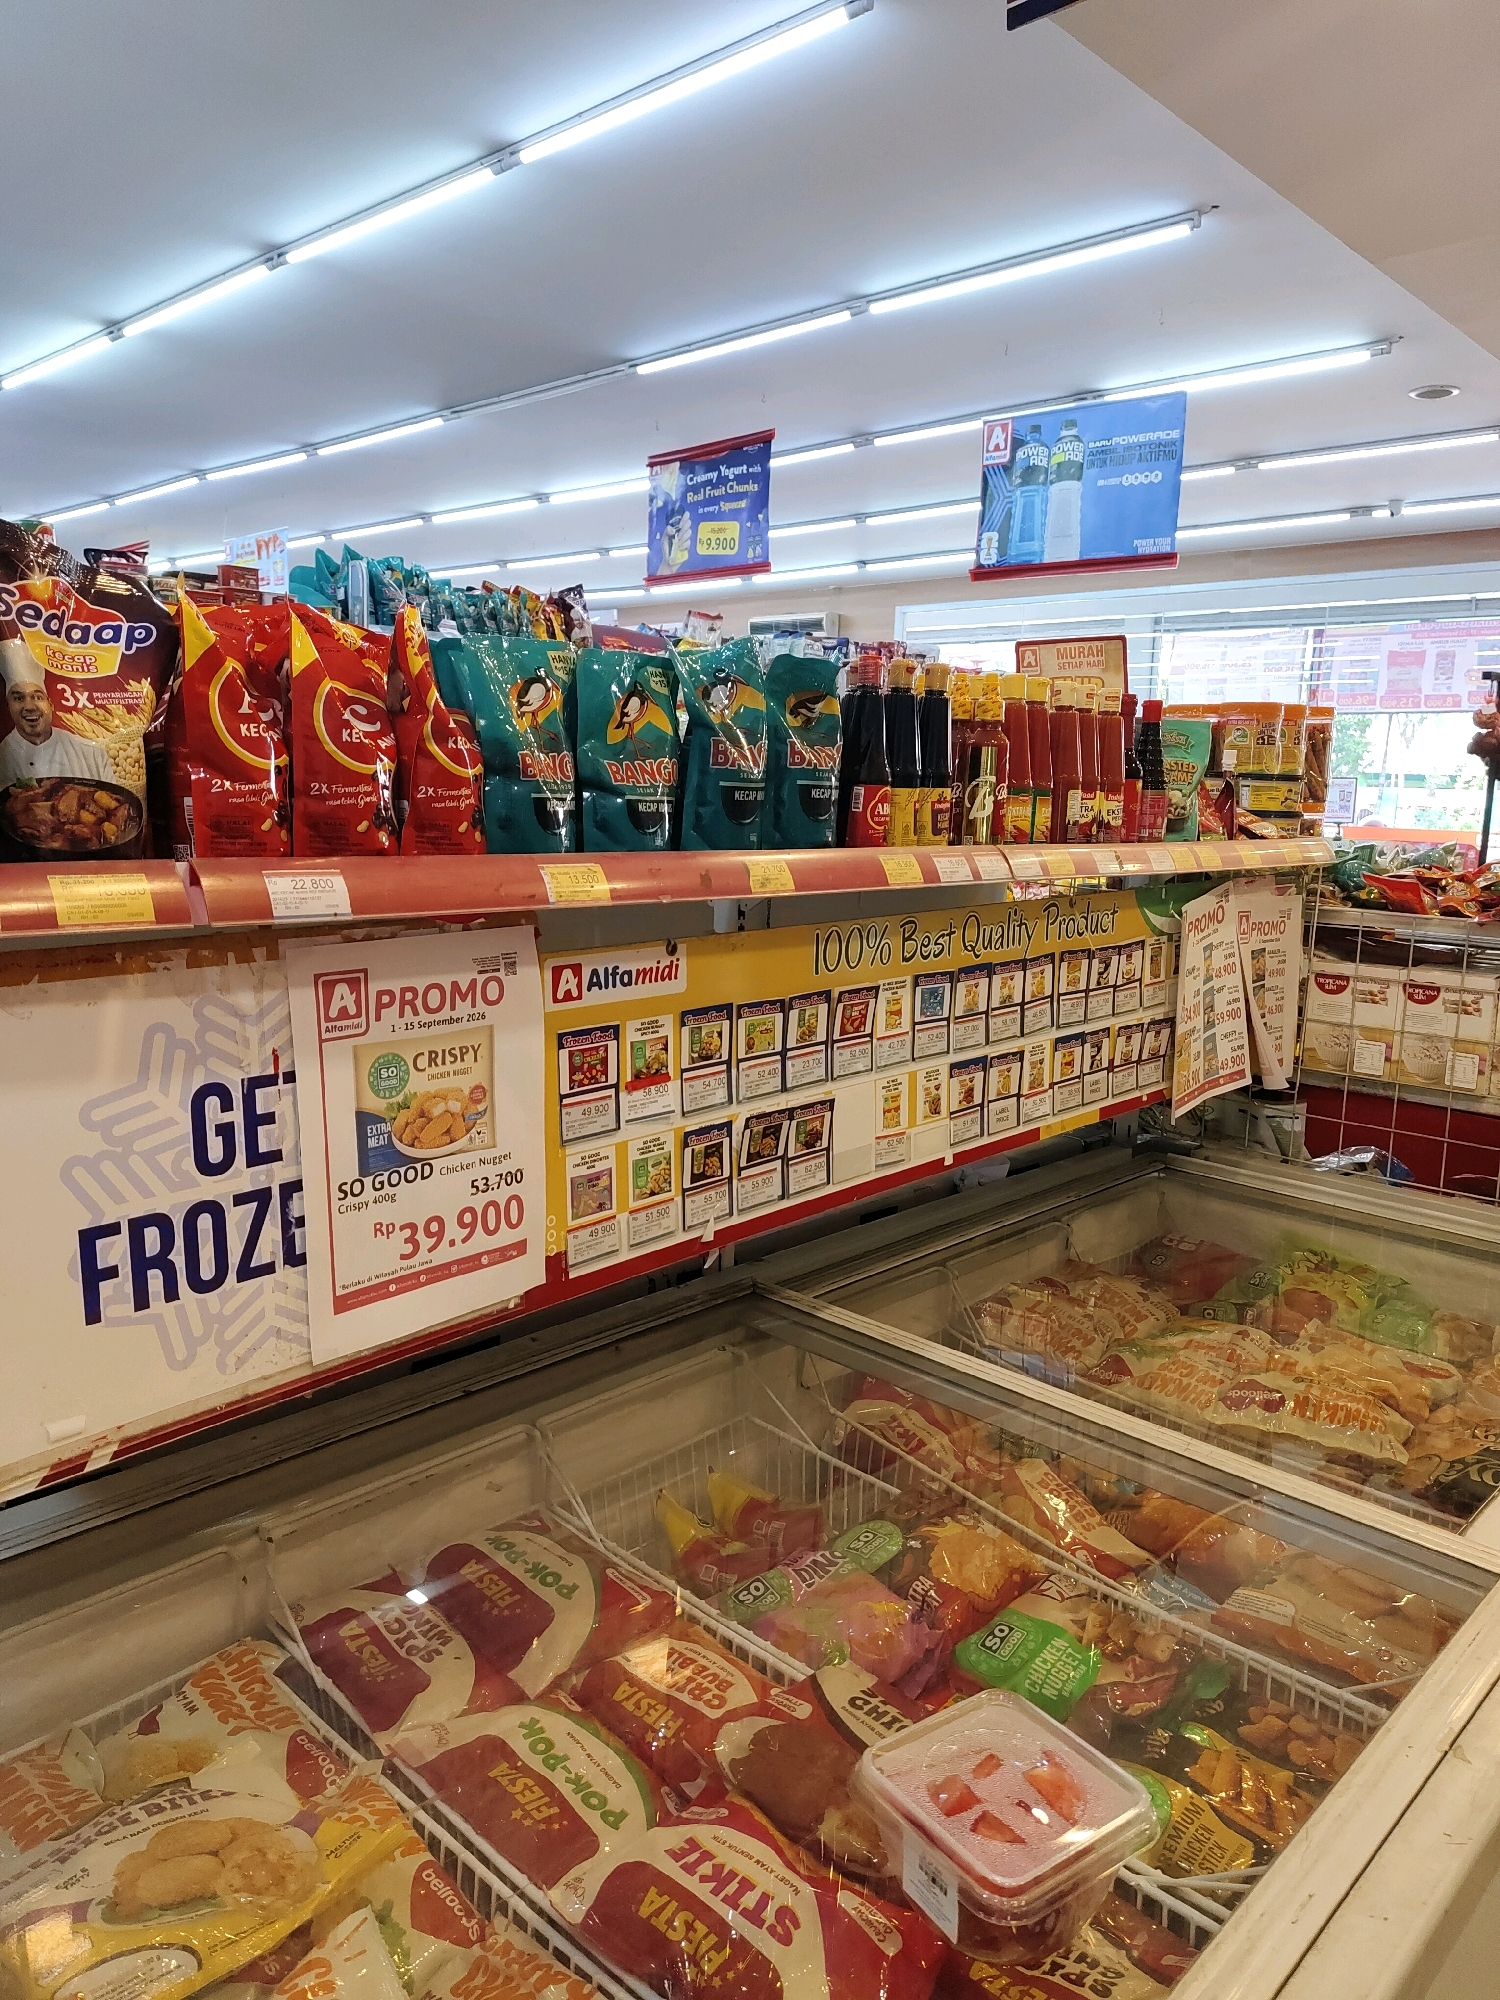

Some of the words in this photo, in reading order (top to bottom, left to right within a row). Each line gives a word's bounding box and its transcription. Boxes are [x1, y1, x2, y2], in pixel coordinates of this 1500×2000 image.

[1088, 439, 1112, 449] BARU
[1111, 429, 1180, 446] POWERADE
[1123, 440, 1178, 453] ISOTONIK
[1016, 446, 1049, 462] POWER
[1051, 442, 1084, 455] POWER
[1065, 450, 1084, 463] ADE
[1029, 455, 1049, 468] ADE
[1086, 457, 1108, 470] UNTUK
[1137, 449, 1178, 463] AKTIFMU
[687, 470, 718, 486] Creamy
[720, 464, 748, 480] Yogurt
[748, 463, 762, 474] with
[687, 488, 704, 503] Real
[705, 485, 726, 499] Fruit
[726, 480, 759, 495] Chunks
[705, 537, 736, 551] 9.900
[1133, 539, 1154, 548] POWER
[1154, 537, 1171, 546] YOUR
[1137, 545, 1171, 554] HYDRATION
[47, 647, 96, 665] kecap
[1056, 643, 1104, 661] MURAH
[48, 659, 98, 673] manis
[1057, 660, 1083, 671] SETIAP
[1086, 659, 1104, 668] HARI
[332, 783, 373, 794] Fermentasi
[437, 787, 473, 798] Fermentasi
[735, 790, 757, 801] KECAP
[811, 788, 832, 799] KECAP
[638, 802, 657, 813] KECAP
[760, 865, 786, 874] 21.700
[291, 878, 334, 890] 22.800
[568, 874, 600, 886] 13.500
[1187, 904, 1225, 938] PROMO
[1250, 920, 1286, 938] PROMO
[814, 921, 892, 977] 100%
[900, 917, 957, 964] Best
[961, 907, 1040, 959] Quality
[1043, 898, 1120, 946] Product
[587, 958, 681, 993] Alfamidi
[1316, 977, 1348, 986] TROPICANA
[374, 975, 504, 1022] PROMO
[684, 1014, 708, 1026] Frozen
[708, 1010, 727, 1021] Food
[741, 1006, 763, 1017] Frozen
[762, 1003, 780, 1014] Food
[324, 1021, 363, 1035] Alfamidi
[391, 1024, 396, 1033] 1
[404, 1021, 415, 1031] 15
[417, 1014, 465, 1030] September
[467, 1012, 486, 1023] 2026
[563, 1036, 591, 1047] Frozen
[591, 1029, 614, 1042] Food
[412, 1043, 482, 1072] CRISPY
[802, 1056, 823, 1069] 23.700
[380, 1067, 397, 1078] SO
[427, 1071, 451, 1082] CHICKEN
[452, 1067, 473, 1078] NUGGET
[757, 1066, 780, 1079] 52.400
[380, 1079, 398, 1087] GOOD
[642, 1083, 669, 1098] 58.900
[702, 1076, 726, 1090] 54.700
[581, 1103, 610, 1117] 49.900
[794, 1107, 813, 1119] Frozen
[813, 1102, 830, 1115] Food
[749, 1115, 771, 1127] Frozen
[771, 1111, 788, 1123] Food
[367, 1122, 392, 1136] EXTRA
[688, 1133, 710, 1147] Frozen
[710, 1127, 728, 1141] Food
[367, 1134, 389, 1149] MEAT
[337, 1180, 365, 1201] SO
[371, 1162, 434, 1192] GOOD
[439, 1160, 476, 1176] Chicken
[478, 1151, 512, 1168] Nugget
[470, 1168, 525, 1197] 53.700
[751, 1175, 774, 1190] 55.900
[338, 1199, 370, 1214] Crispy
[372, 1191, 397, 1205] 400g
[703, 1189, 727, 1203] 55.700
[645, 1205, 670, 1221] 51.500
[373, 1221, 396, 1239] Rp
[399, 1194, 525, 1261] 39.900
[588, 1222, 616, 1238] 49.900
[373, 1268, 399, 1280] Wilayah
[400, 1263, 417, 1273] Pulau
[417, 1258, 433, 1268] Jawa
[849, 1532, 875, 1550] SO
[861, 1537, 884, 1553] GOOD
[484, 1534, 581, 1601] POK-POK
[459, 1558, 522, 1608] FIESTA
[738, 1580, 765, 1604] SO
[338, 1619, 399, 1676] FIESTA
[984, 1624, 1011, 1651] SO
[1000, 1631, 1023, 1657] GOOD
[1024, 1636, 1070, 1694] CHICKEN
[1041, 1647, 1083, 1700] NUGGET
[175, 1690, 200, 1717] AYAM
[612, 1680, 686, 1739] FIESTA
[585, 1752, 600, 1768] AYAM
[518, 1717, 631, 1831] POK-POK
[600, 1767, 622, 1790] DAGING
[486, 1759, 560, 1821] FIESTA
[187, 1808, 210, 1819] KEJU
[710, 1833, 728, 1847] STIK
[728, 1842, 755, 1862] BENTUK
[1176, 1822, 1216, 1875] CHICKEN
[1198, 1839, 1230, 1875] STICK
[754, 1857, 775, 1875] AYAM
[663, 1834, 802, 1947] STIKIE
[775, 1873, 801, 1897] NAGET
[637, 1885, 732, 1976] FIESTA
